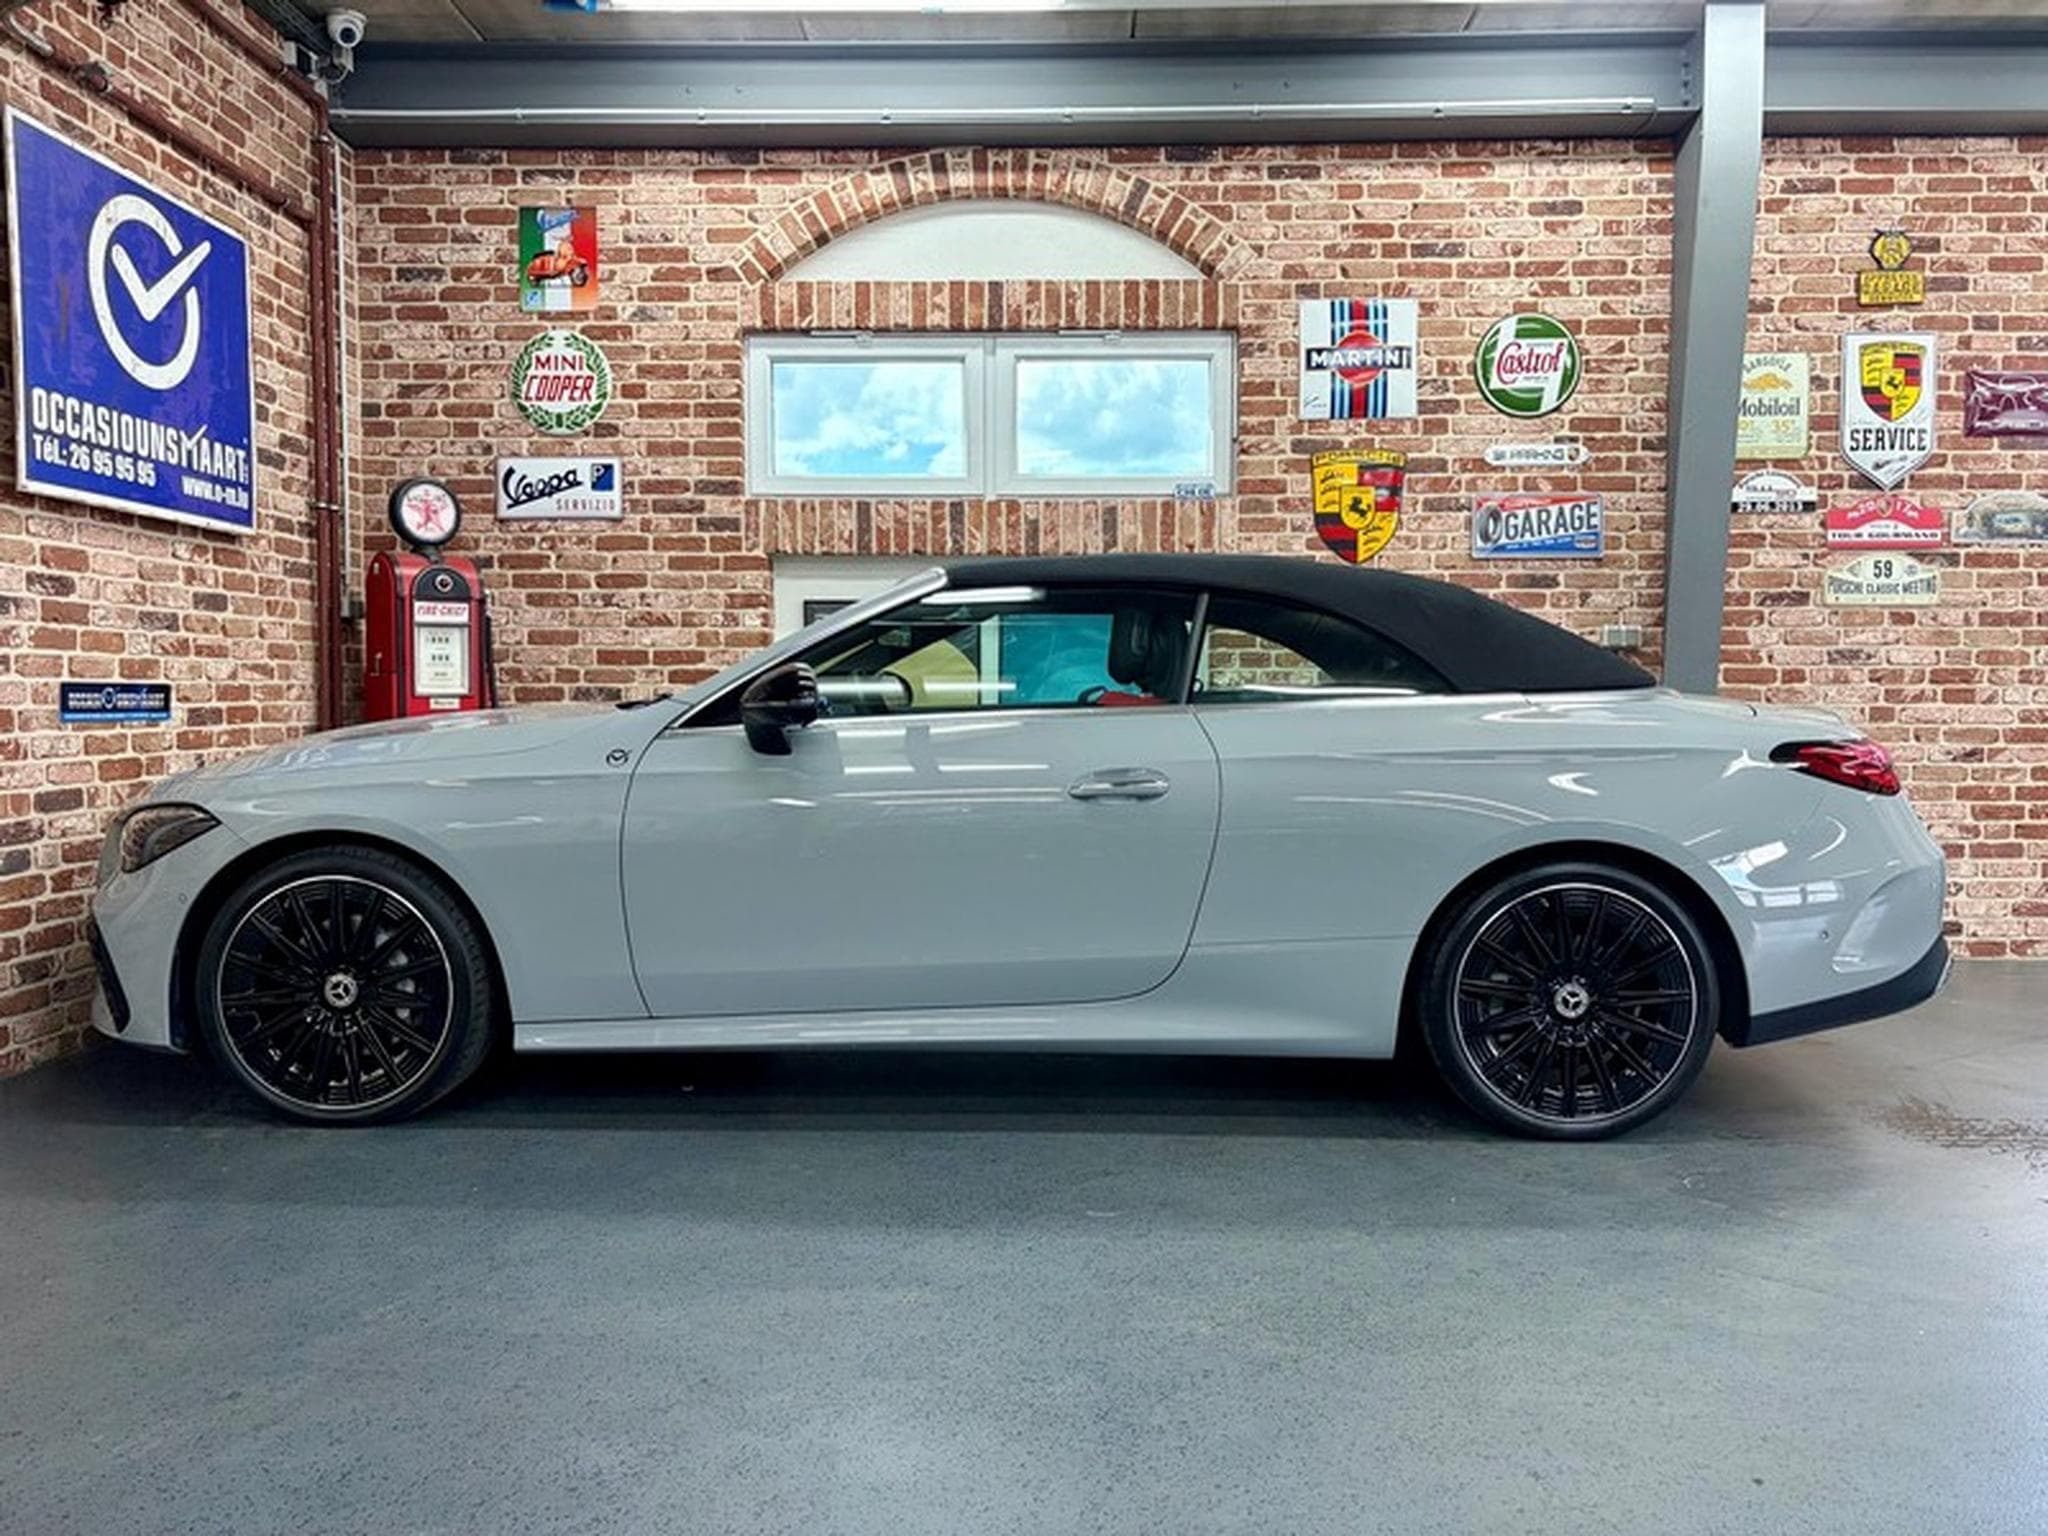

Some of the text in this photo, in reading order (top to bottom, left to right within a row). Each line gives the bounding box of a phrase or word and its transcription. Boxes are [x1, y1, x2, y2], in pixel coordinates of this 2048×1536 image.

[533, 353, 585, 372] MINI
[1309, 349, 1410, 369] MARTINI
[1496, 341, 1566, 386] Castrol
[524, 374, 595, 403] COOPER
[1849, 427, 1928, 452] SERVICE
[68, 442, 91, 472] 26
[91, 449, 114, 478] 95
[114, 454, 136, 482] 95
[136, 459, 157, 488] 95
[502, 466, 585, 511] Vespa
[555, 499, 617, 512] SERVIZIO
[1504, 500, 1599, 541] GARAGE
[1873, 559, 1893, 579] 59
